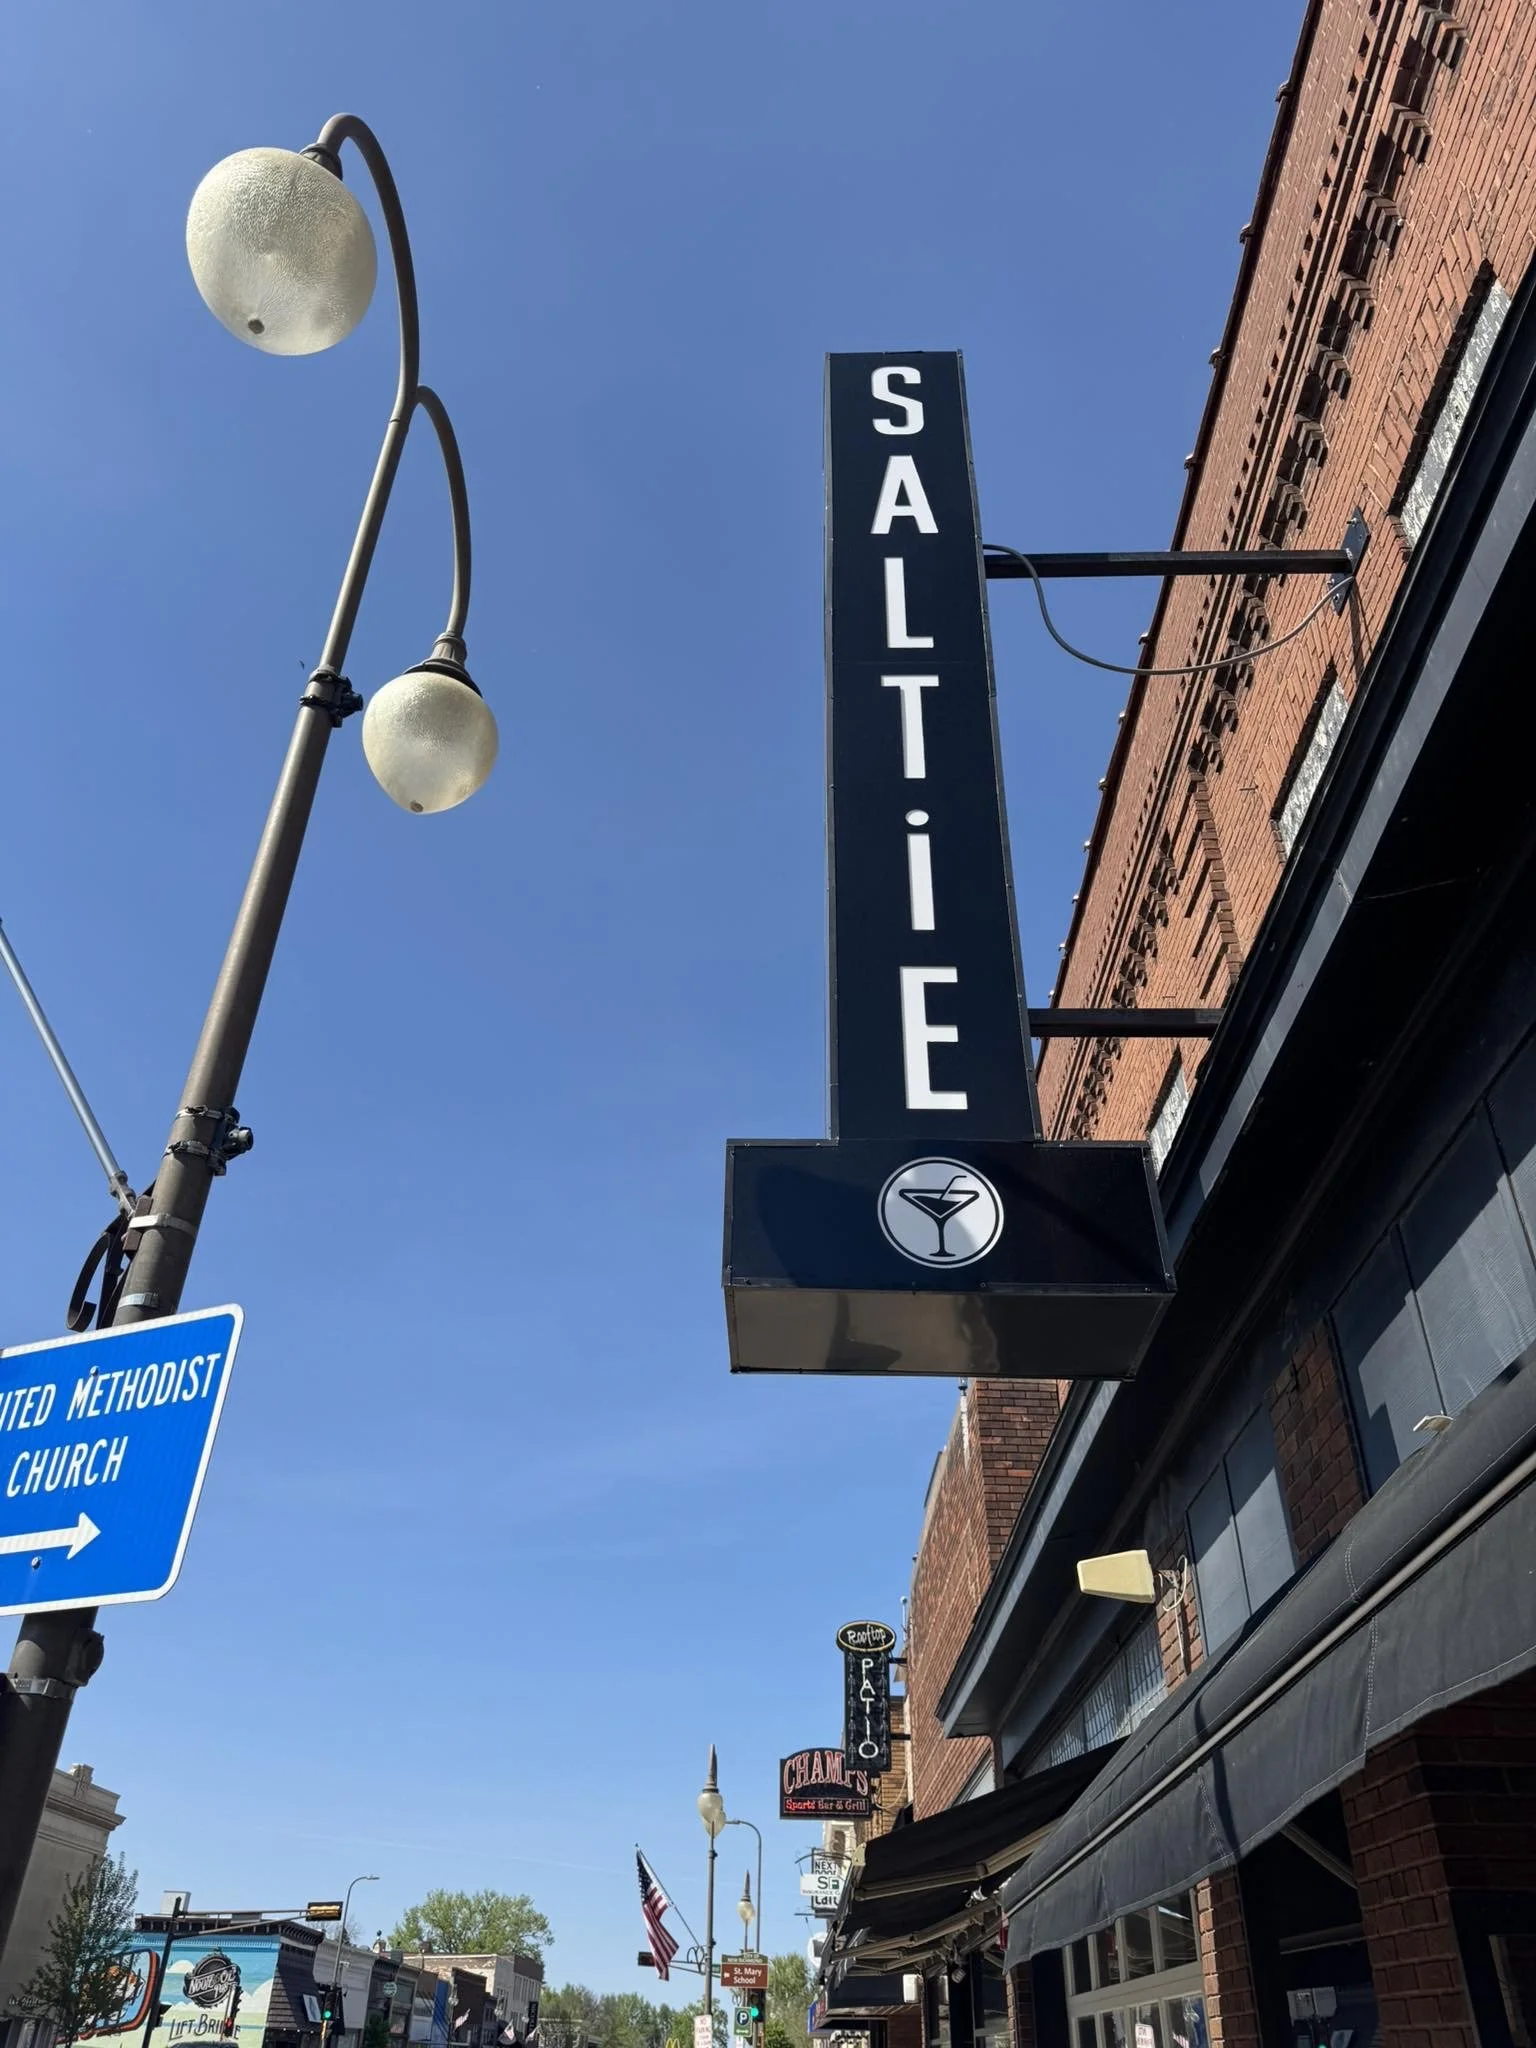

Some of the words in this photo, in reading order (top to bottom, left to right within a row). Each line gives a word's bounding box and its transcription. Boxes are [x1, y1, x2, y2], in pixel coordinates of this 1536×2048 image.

[870, 365, 968, 1111] SALTiE
[0, 1383, 56, 1432] ITED
[66, 1353, 221, 1421] METHODIST
[6, 1436, 129, 1498] CHURCH
[846, 1623, 887, 1646] Rooftop
[859, 1658, 879, 1759] PATIO
[786, 1799, 816, 1811] Sports
[817, 1799, 834, 1810] Bar
[835, 1800, 844, 1810] &
[845, 1799, 867, 1811] Grill
[733, 1967, 743, 1975] St.
[744, 1967, 762, 1977] Mary
[733, 1976, 756, 1984] School
[193, 2013, 241, 2040] BRIE
